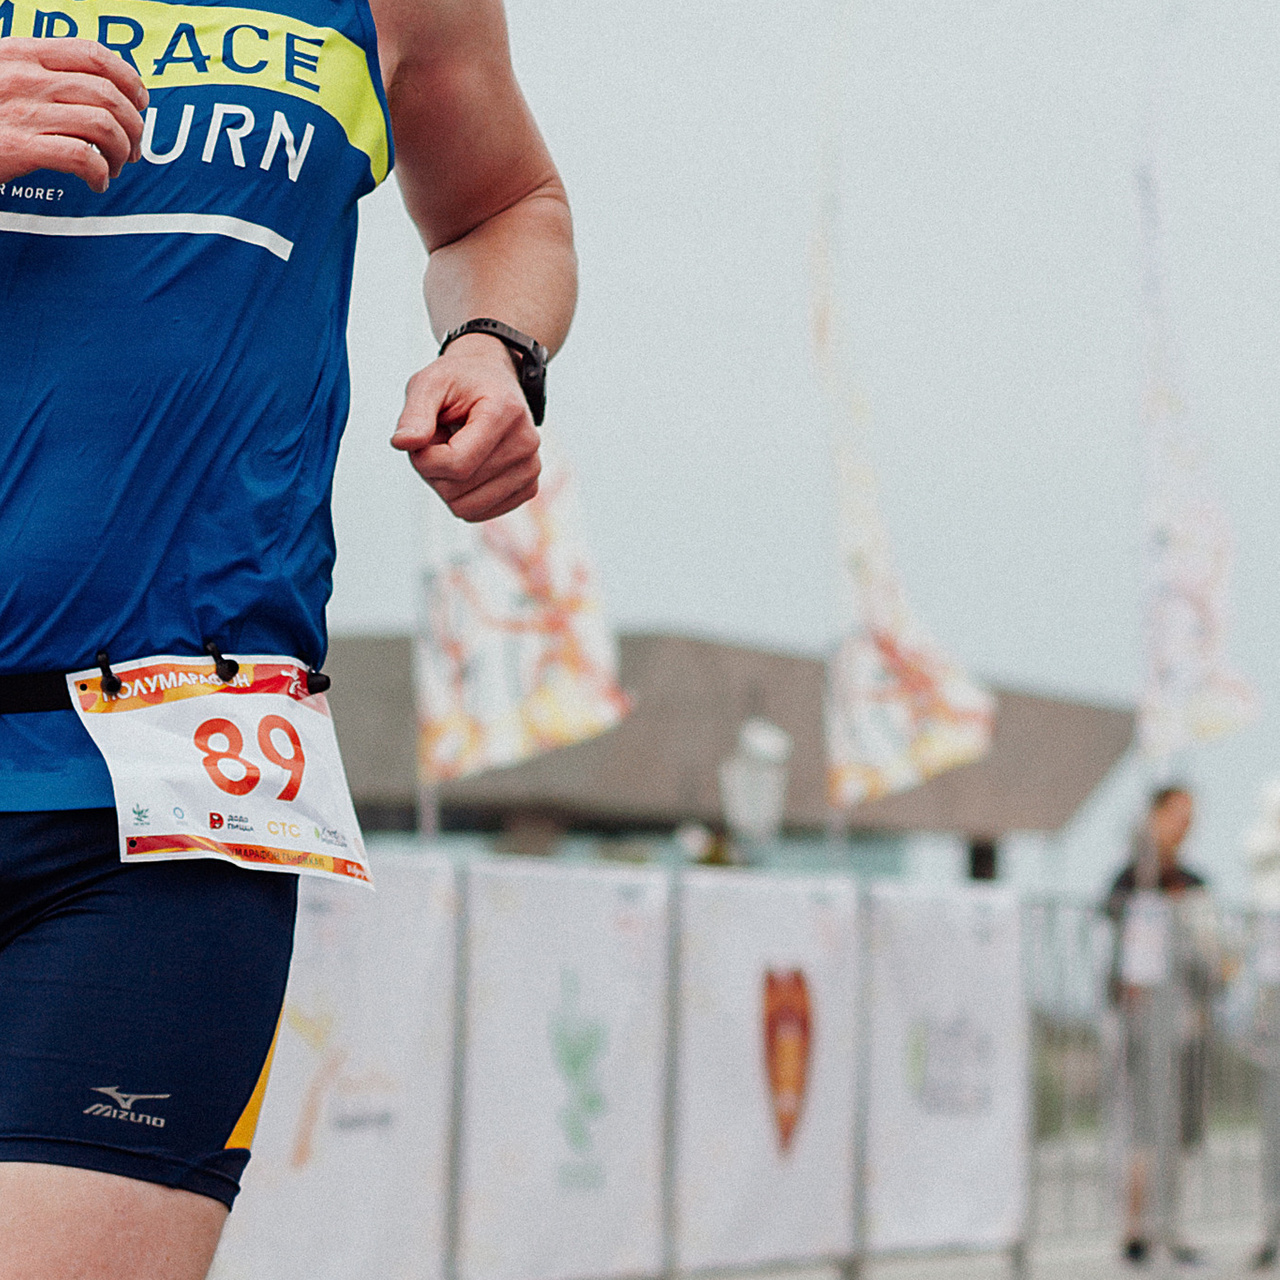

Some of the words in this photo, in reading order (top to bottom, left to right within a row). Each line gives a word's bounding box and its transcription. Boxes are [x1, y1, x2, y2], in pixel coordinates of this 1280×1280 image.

[140, 102, 316, 183] URN
[11, 185, 65, 201] MORE?
[102, 671, 251, 703] ОЛУМАРАФН
[193, 713, 306, 802] 89
[82, 1103, 166, 1128] MIZUNO
